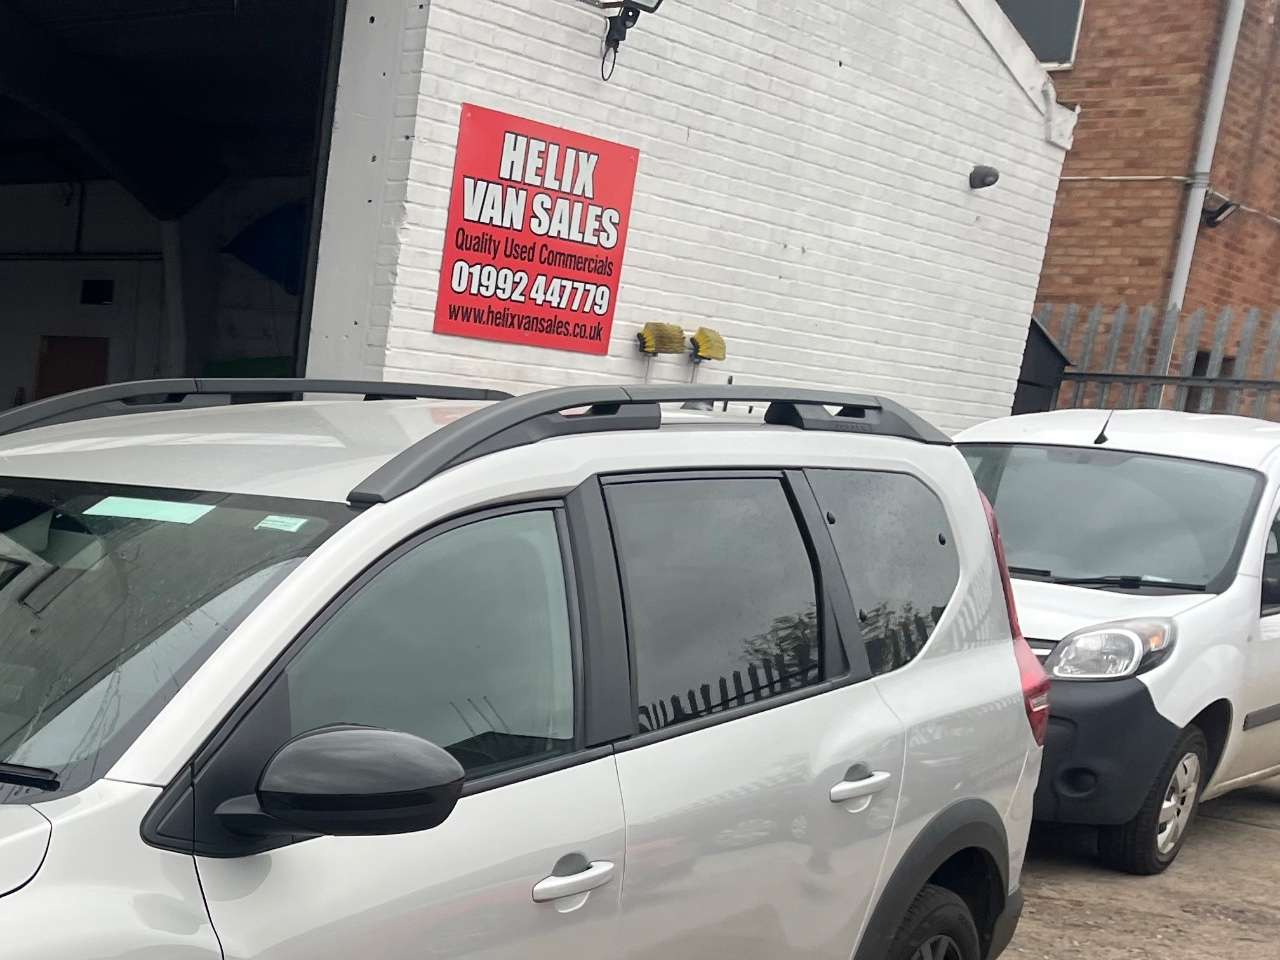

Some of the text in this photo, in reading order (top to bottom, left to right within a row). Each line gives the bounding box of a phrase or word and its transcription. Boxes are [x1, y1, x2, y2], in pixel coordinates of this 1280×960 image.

[499, 131, 599, 199] HELIX
[463, 176, 620, 249] VAN SALES
[455, 227, 614, 277] Quality Used Commercials
[451, 260, 610, 316] 01992 447779
[448, 303, 603, 341] www.helixvansales.co.uk
